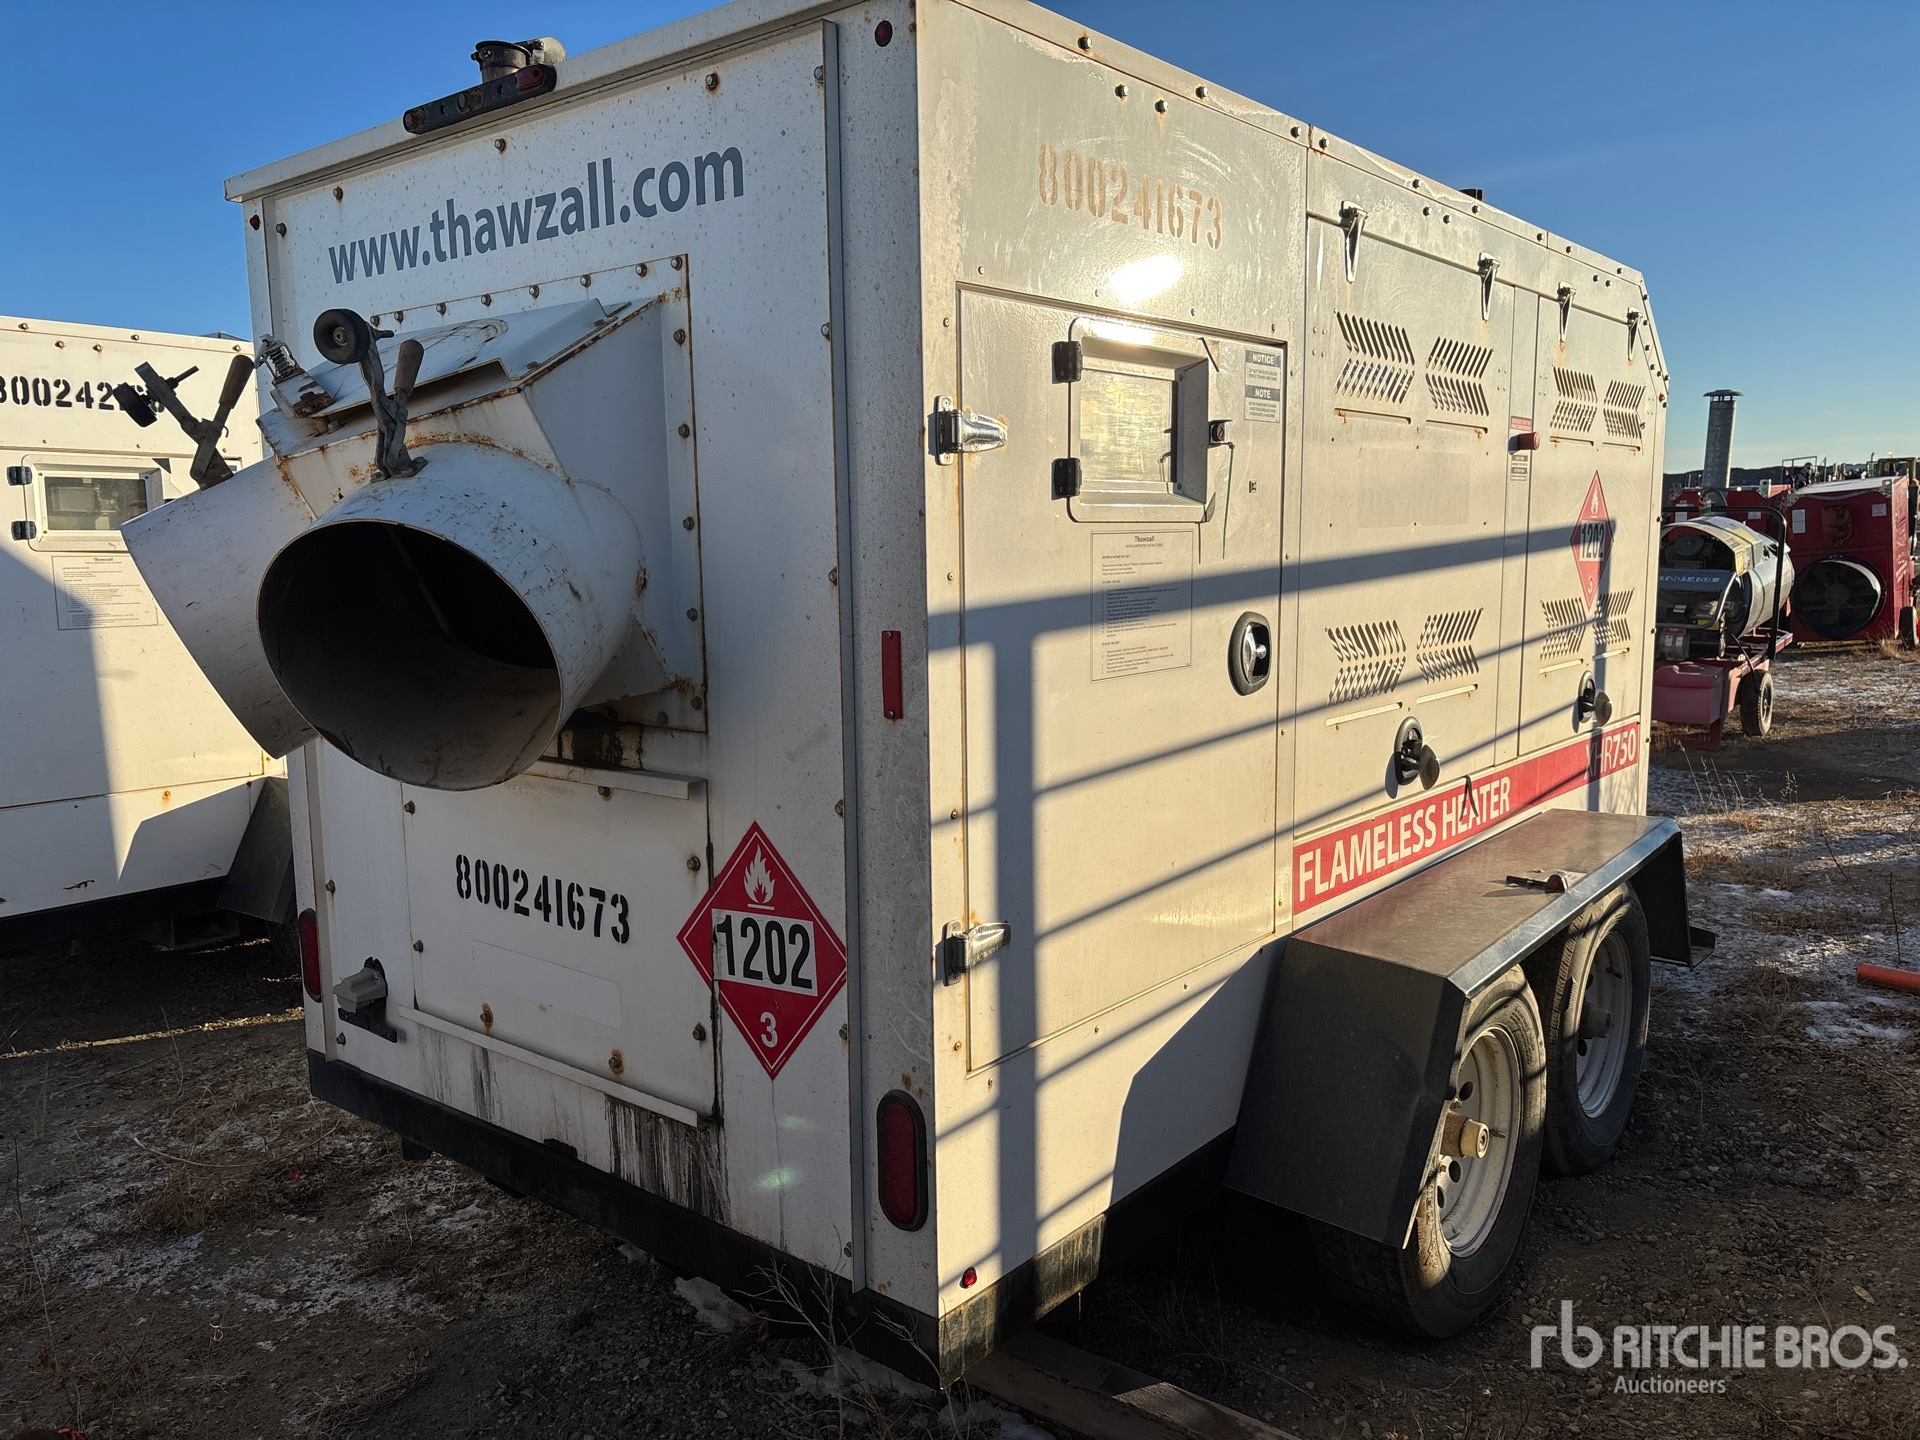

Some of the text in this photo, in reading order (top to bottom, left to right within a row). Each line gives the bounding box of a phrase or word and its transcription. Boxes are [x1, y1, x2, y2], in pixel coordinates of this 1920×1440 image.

[328, 146, 745, 285] www.thawzall.com
[1038, 143, 1222, 250] 800241673
[1252, 353, 1275, 365] NOTICE
[1255, 388, 1271, 398] NOTE
[1581, 523, 1605, 559] 1202
[1587, 575, 1593, 594] 3
[1583, 727, 1637, 781] XHR750
[1299, 776, 1511, 902] FLAMELESS HEATER
[455, 854, 631, 944] 800241673
[716, 914, 813, 990] 1202
[760, 1011, 778, 1048] 3
